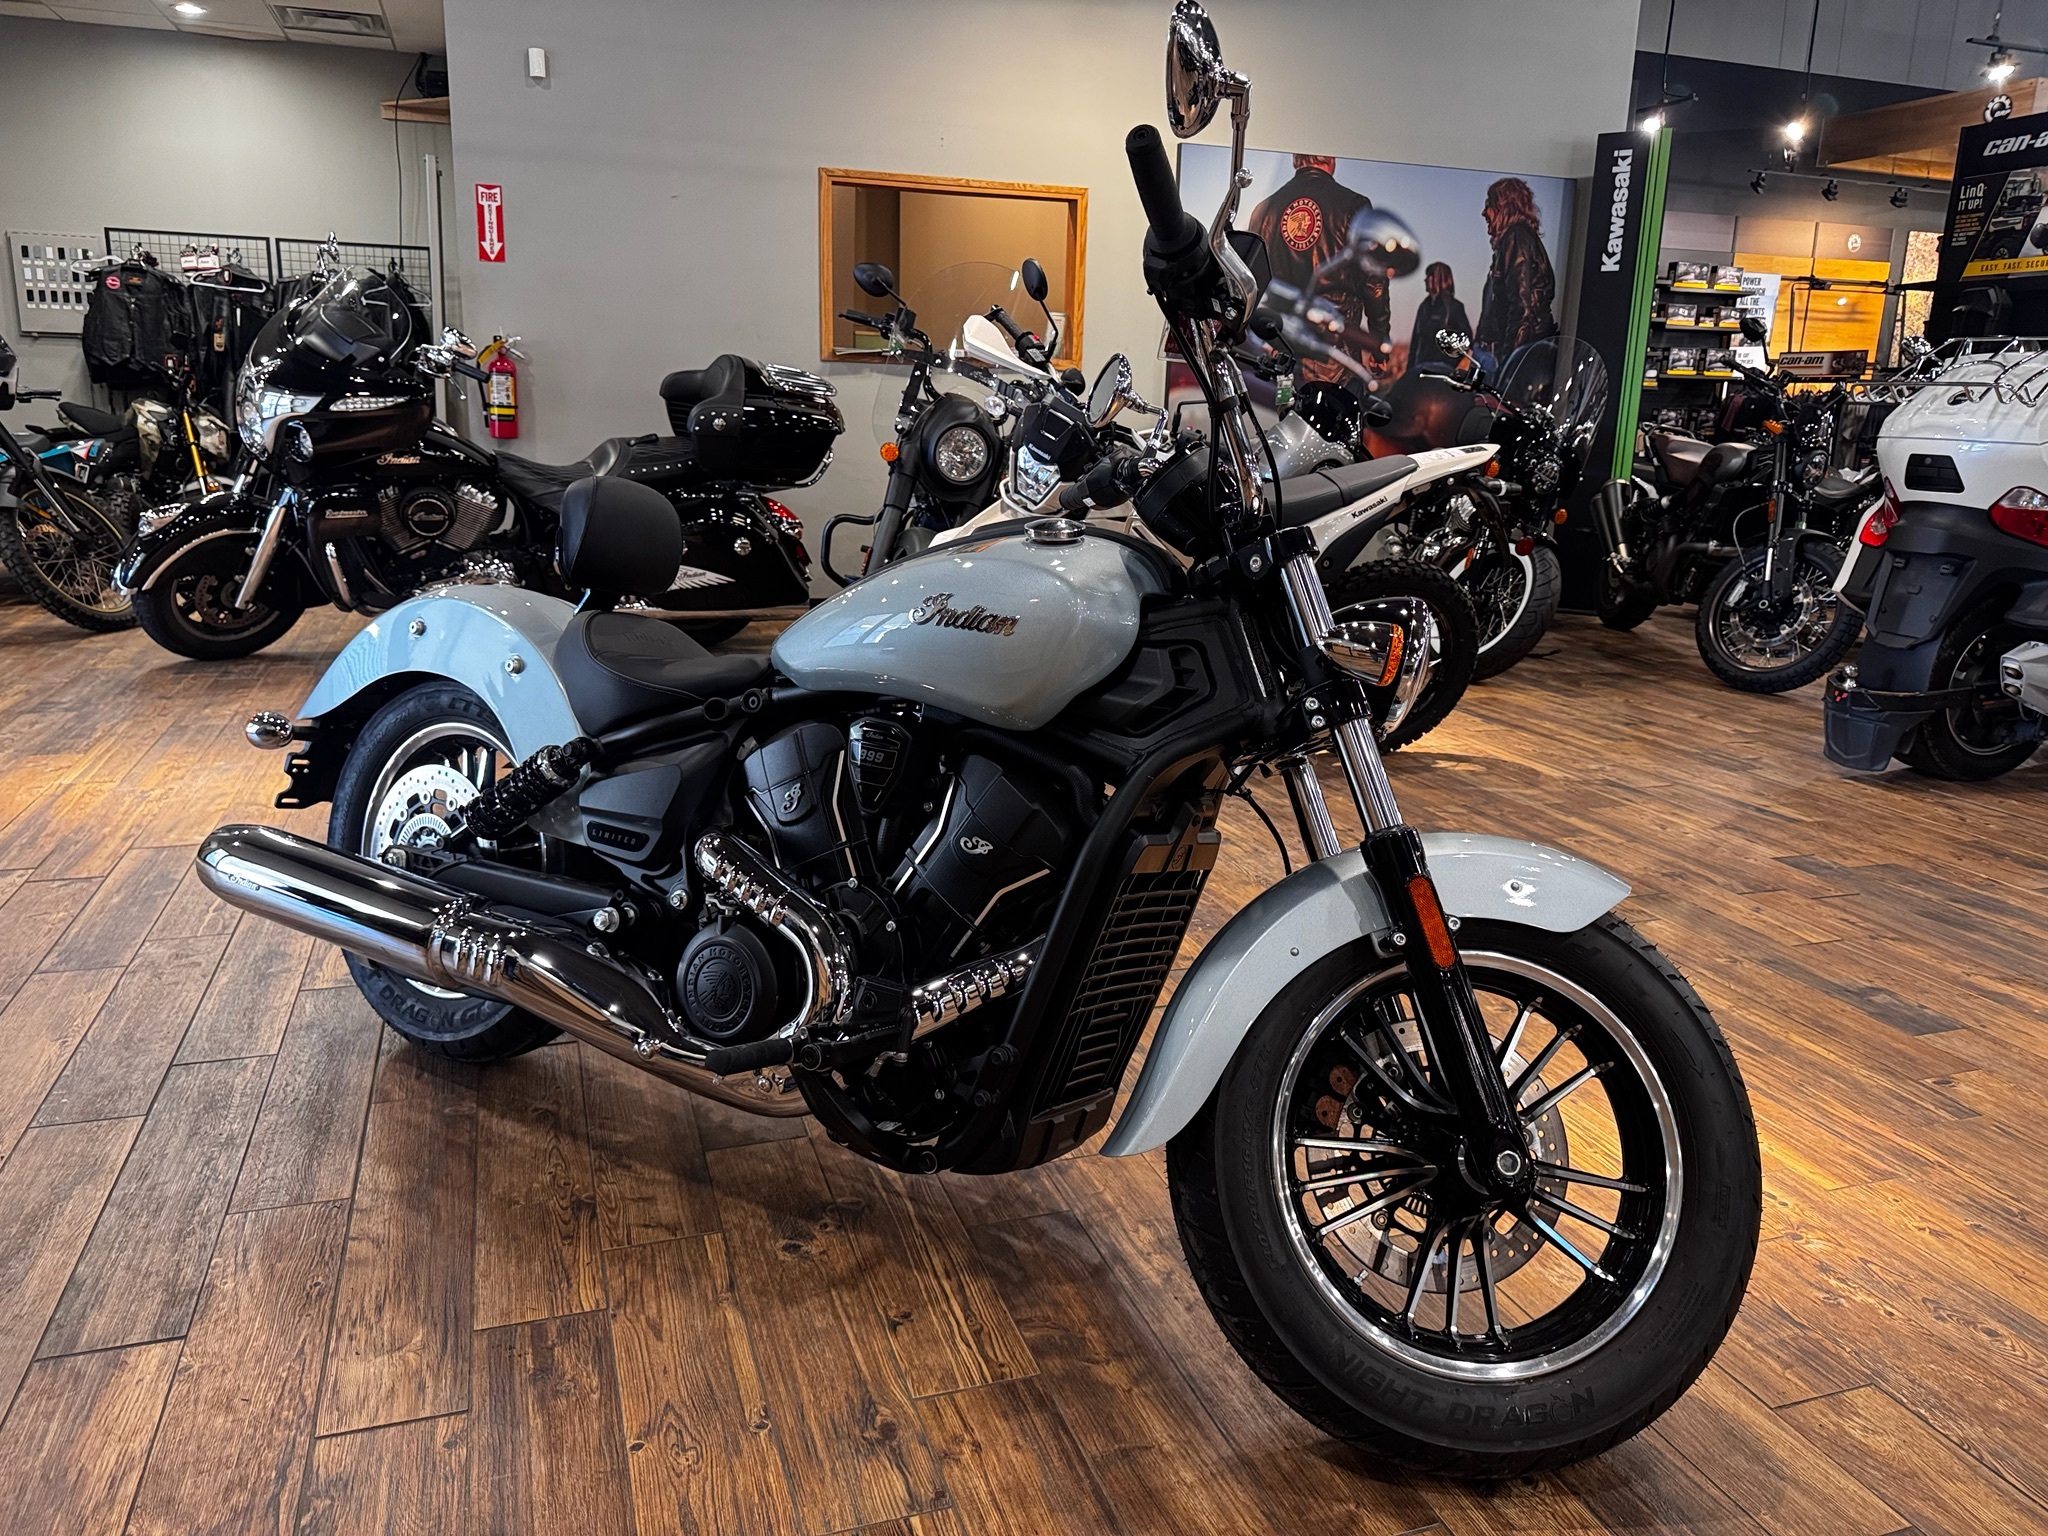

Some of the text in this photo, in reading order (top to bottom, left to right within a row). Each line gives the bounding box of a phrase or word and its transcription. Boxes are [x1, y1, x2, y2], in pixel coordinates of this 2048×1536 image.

[480, 191, 499, 203] FIRE
[1960, 183, 1985, 199] LinQ
[1600, 149, 1633, 272] Kawasaki
[1957, 199, 1983, 211] IT UP!
[1282, 199, 1321, 241] INDIAN MOTORCYCLE
[487, 203, 495, 255] EXTINGUISHER
[1980, 264, 2000, 272] EASY.
[2003, 262, 2022, 270] FAST.
[1742, 276, 1762, 286] POWER
[1739, 297, 1760, 306] ALL THE
[1780, 356, 1825, 365] can-am
[376, 453, 421, 466] Indian
[1351, 495, 1389, 519] Kawasaki
[908, 591, 1021, 637] Indian
[592, 828, 637, 845] LIMITED
[688, 947, 752, 1023] INDIAN MOTORCYCLE
[379, 984, 454, 1028] DRAGON
[1329, 1343, 1596, 1430] NIGHT DRAGON
